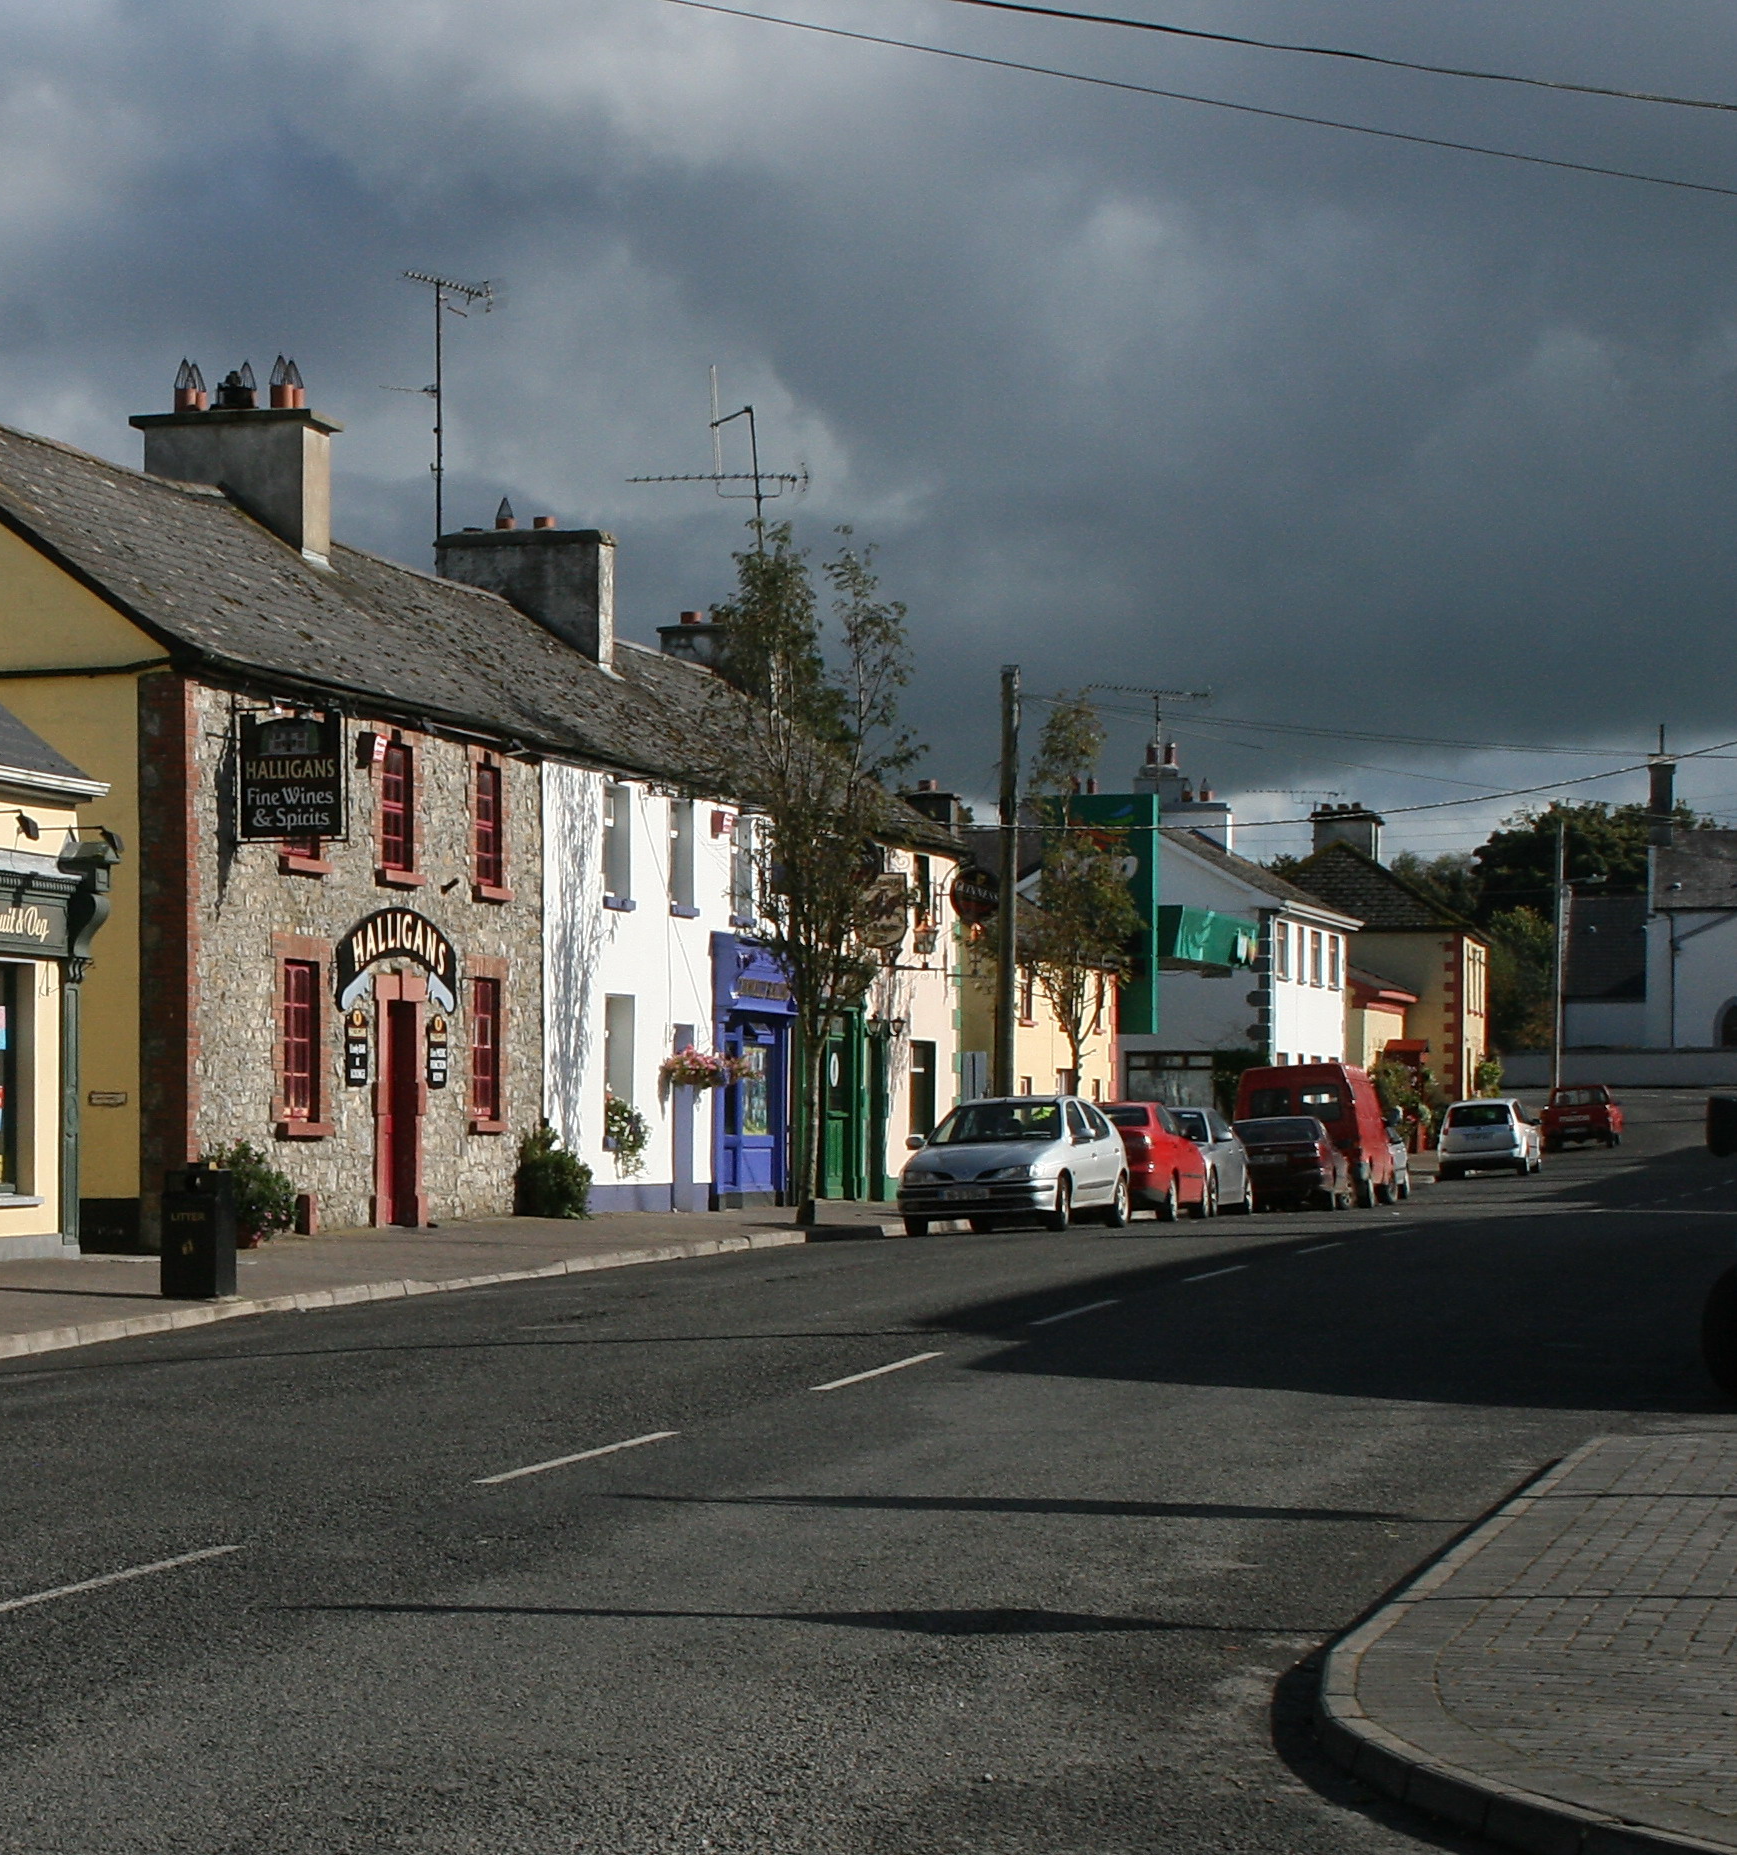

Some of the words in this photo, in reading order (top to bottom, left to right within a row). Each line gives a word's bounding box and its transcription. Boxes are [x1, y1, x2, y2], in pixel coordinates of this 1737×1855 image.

[245, 759, 335, 780] HALLIGANS
[247, 788, 280, 806] Fine
[281, 786, 335, 805] Wines
[252, 808, 273, 827] &
[275, 807, 330, 832] Spirits
[15, 907, 23, 934] &
[24, 906, 50, 943] Veg
[351, 912, 446, 976] HALLIGANS
[171, 1212, 206, 1222] LITTER
